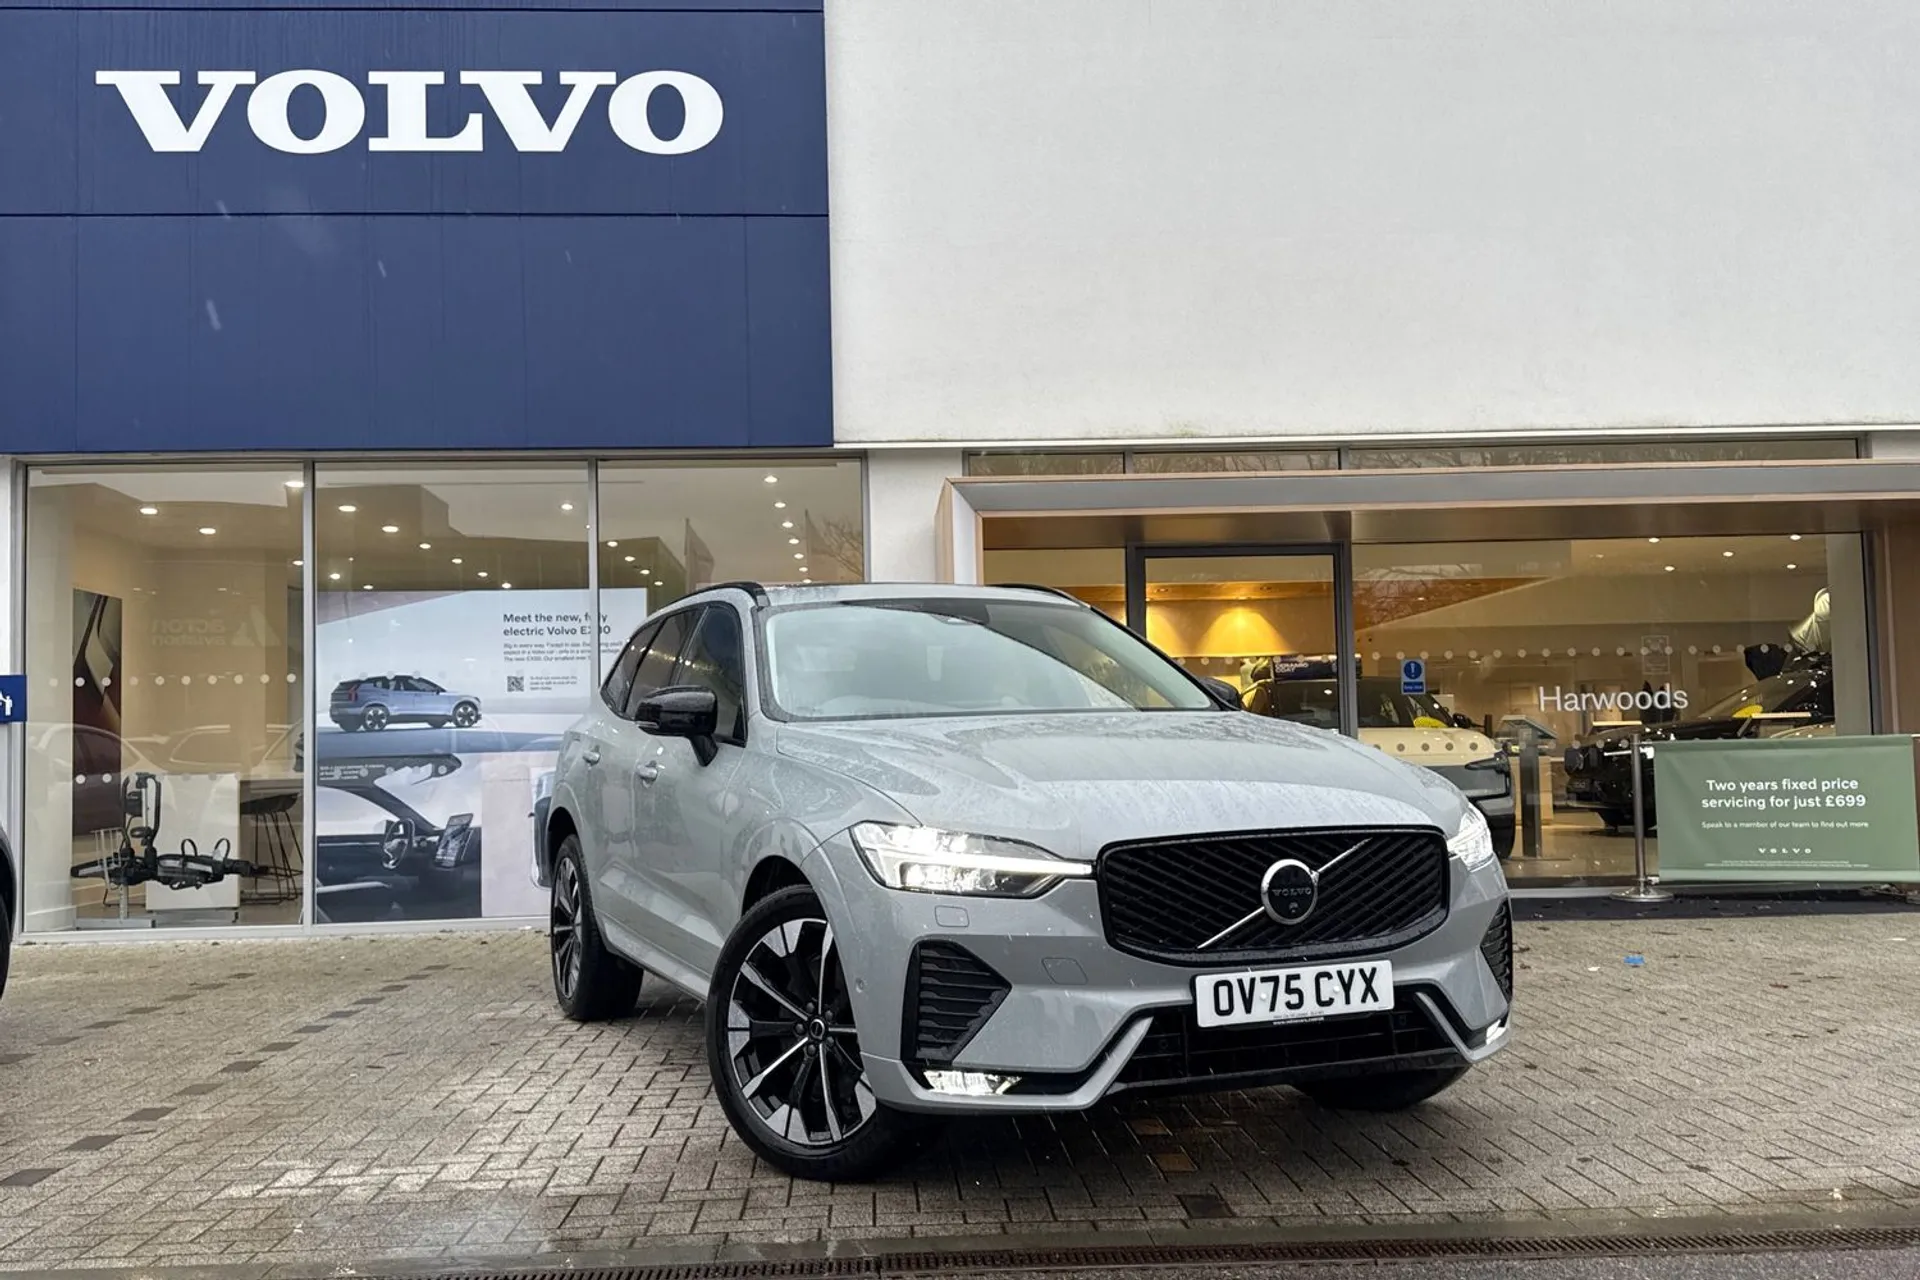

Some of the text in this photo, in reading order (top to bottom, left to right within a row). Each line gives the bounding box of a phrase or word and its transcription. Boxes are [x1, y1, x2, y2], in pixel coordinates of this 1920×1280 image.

[95, 69, 724, 155] VOLVO
[503, 614, 532, 623] Meet
[535, 613, 552, 623] the
[556, 615, 582, 624] new,
[503, 627, 544, 636] electric
[547, 626, 577, 635] Volvo
[1539, 682, 1689, 712] Harwoods
[1706, 778, 1859, 794] Two years fixed price
[1701, 794, 1866, 810] servicing for just £699
[1701, 821, 1723, 829] Speak
[1271, 887, 1312, 897] VOLVO
[1213, 967, 1379, 1017] OV75 CYX
